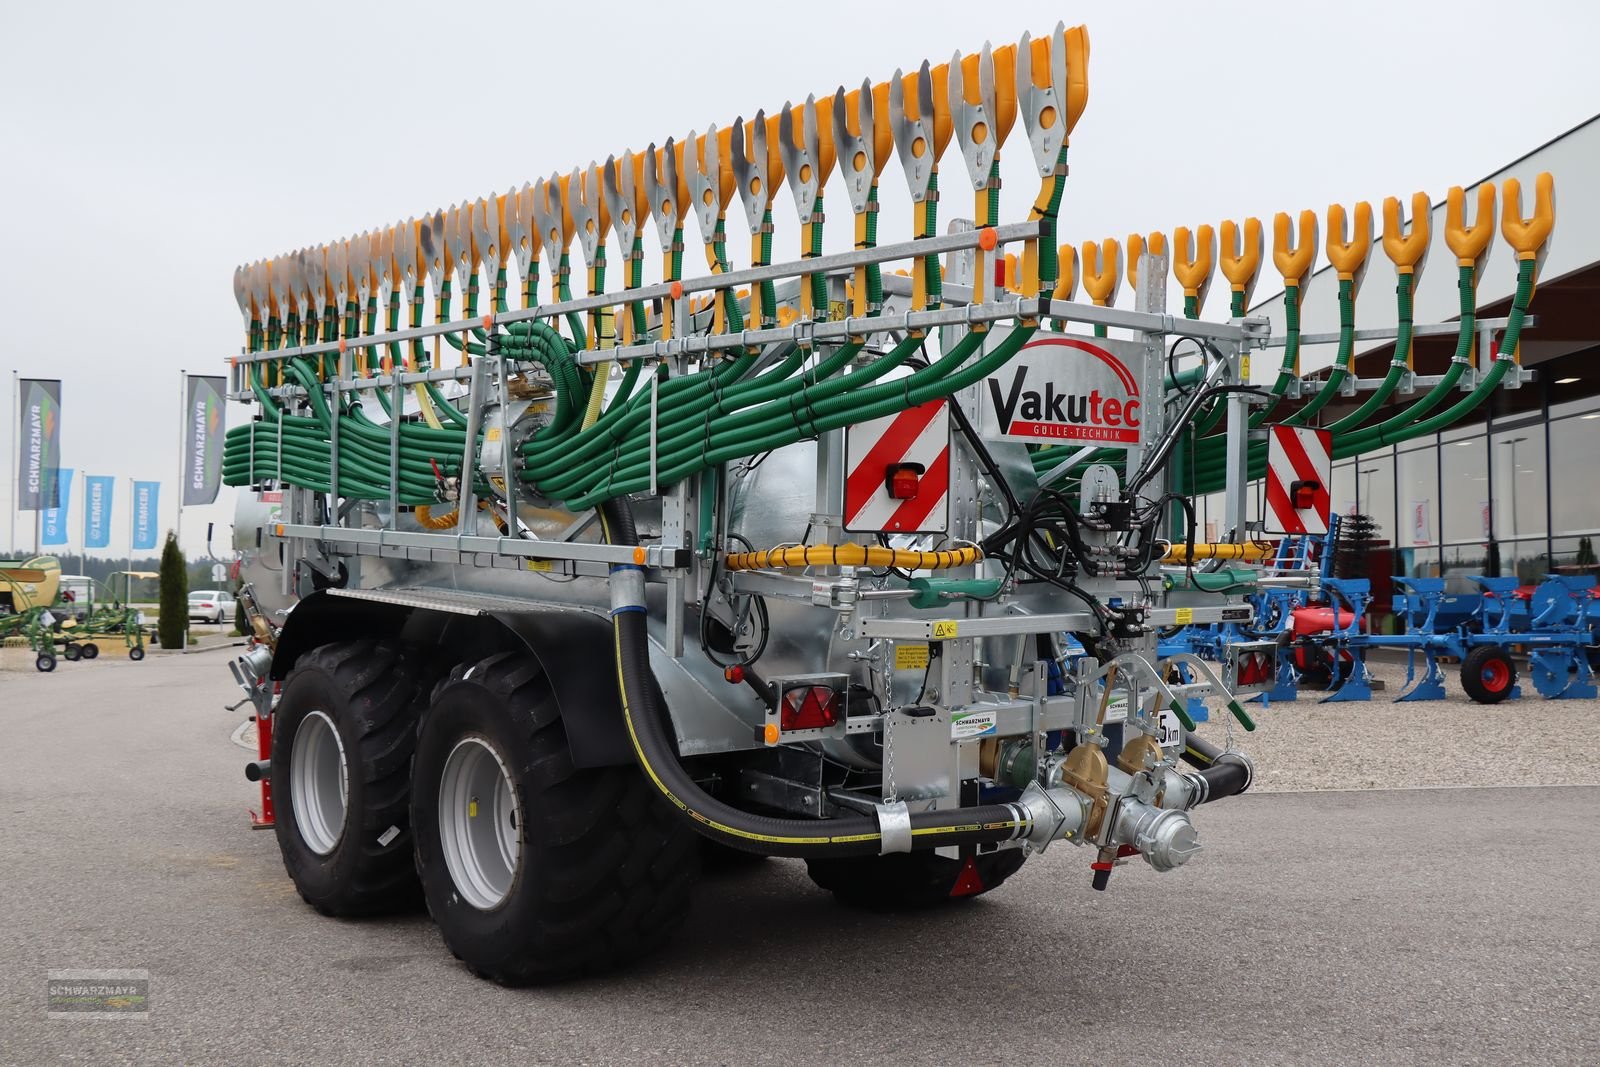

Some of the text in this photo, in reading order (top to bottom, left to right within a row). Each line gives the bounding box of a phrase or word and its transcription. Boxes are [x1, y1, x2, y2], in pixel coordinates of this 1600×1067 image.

[987, 365, 1140, 435] Vakutec
[28, 405, 41, 493] SCHWARZMAYR
[193, 401, 207, 490] SCHWARZMAYR
[93, 482, 103, 529] LEMKEN
[138, 487, 149, 531] LEMKEN
[955, 717, 991, 726] SCHWARZMAYR
